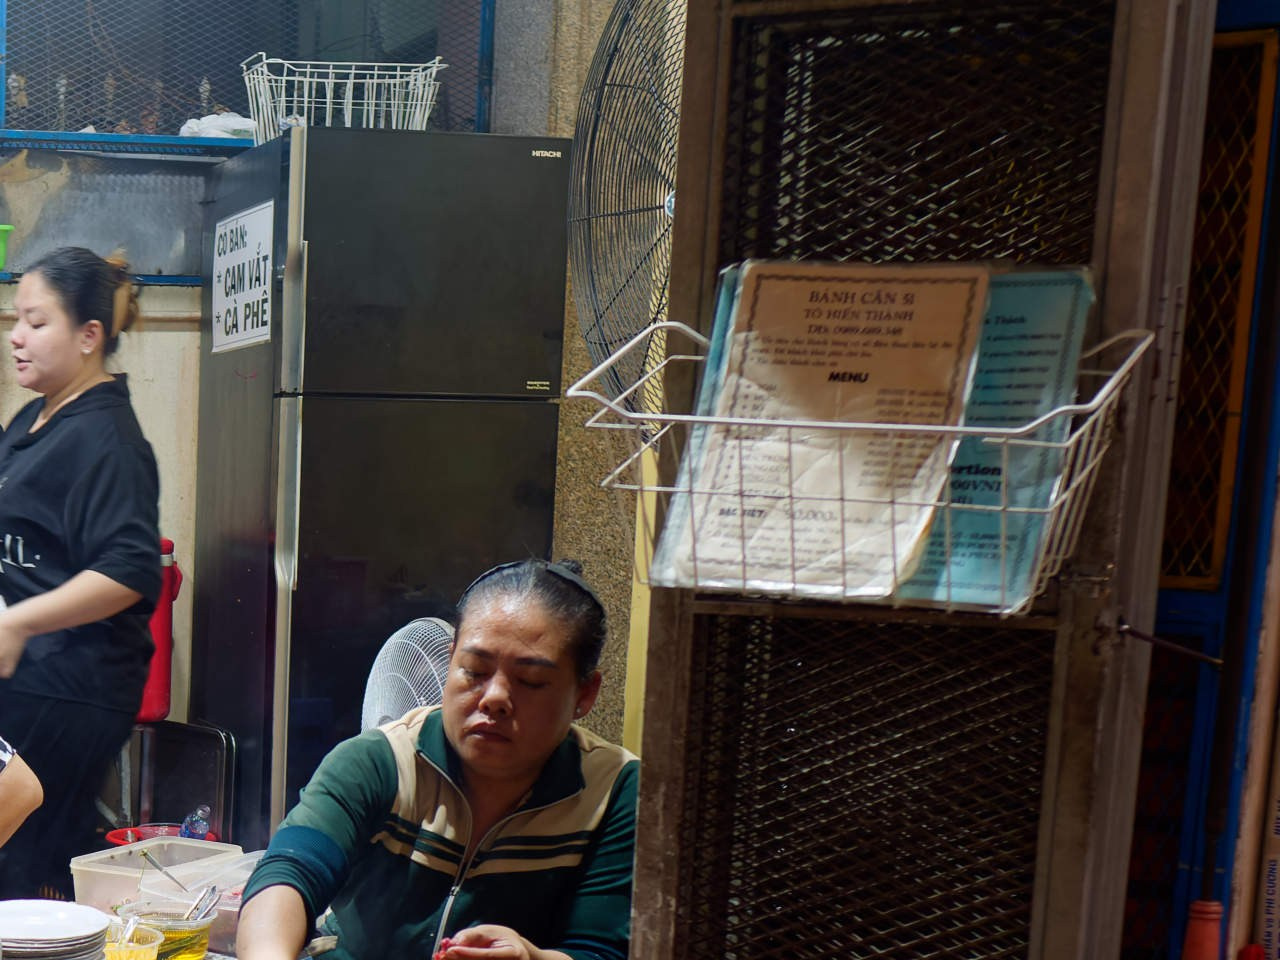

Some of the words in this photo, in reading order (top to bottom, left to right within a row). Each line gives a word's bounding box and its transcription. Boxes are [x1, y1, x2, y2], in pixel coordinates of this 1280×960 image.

[229, 221, 247, 253] BÁN:
[224, 262, 245, 298] CAM
[248, 242, 269, 290] VẮT
[224, 299, 239, 336] CÀ
[243, 290, 268, 331] PHÊ
[828, 371, 869, 383] MENU
